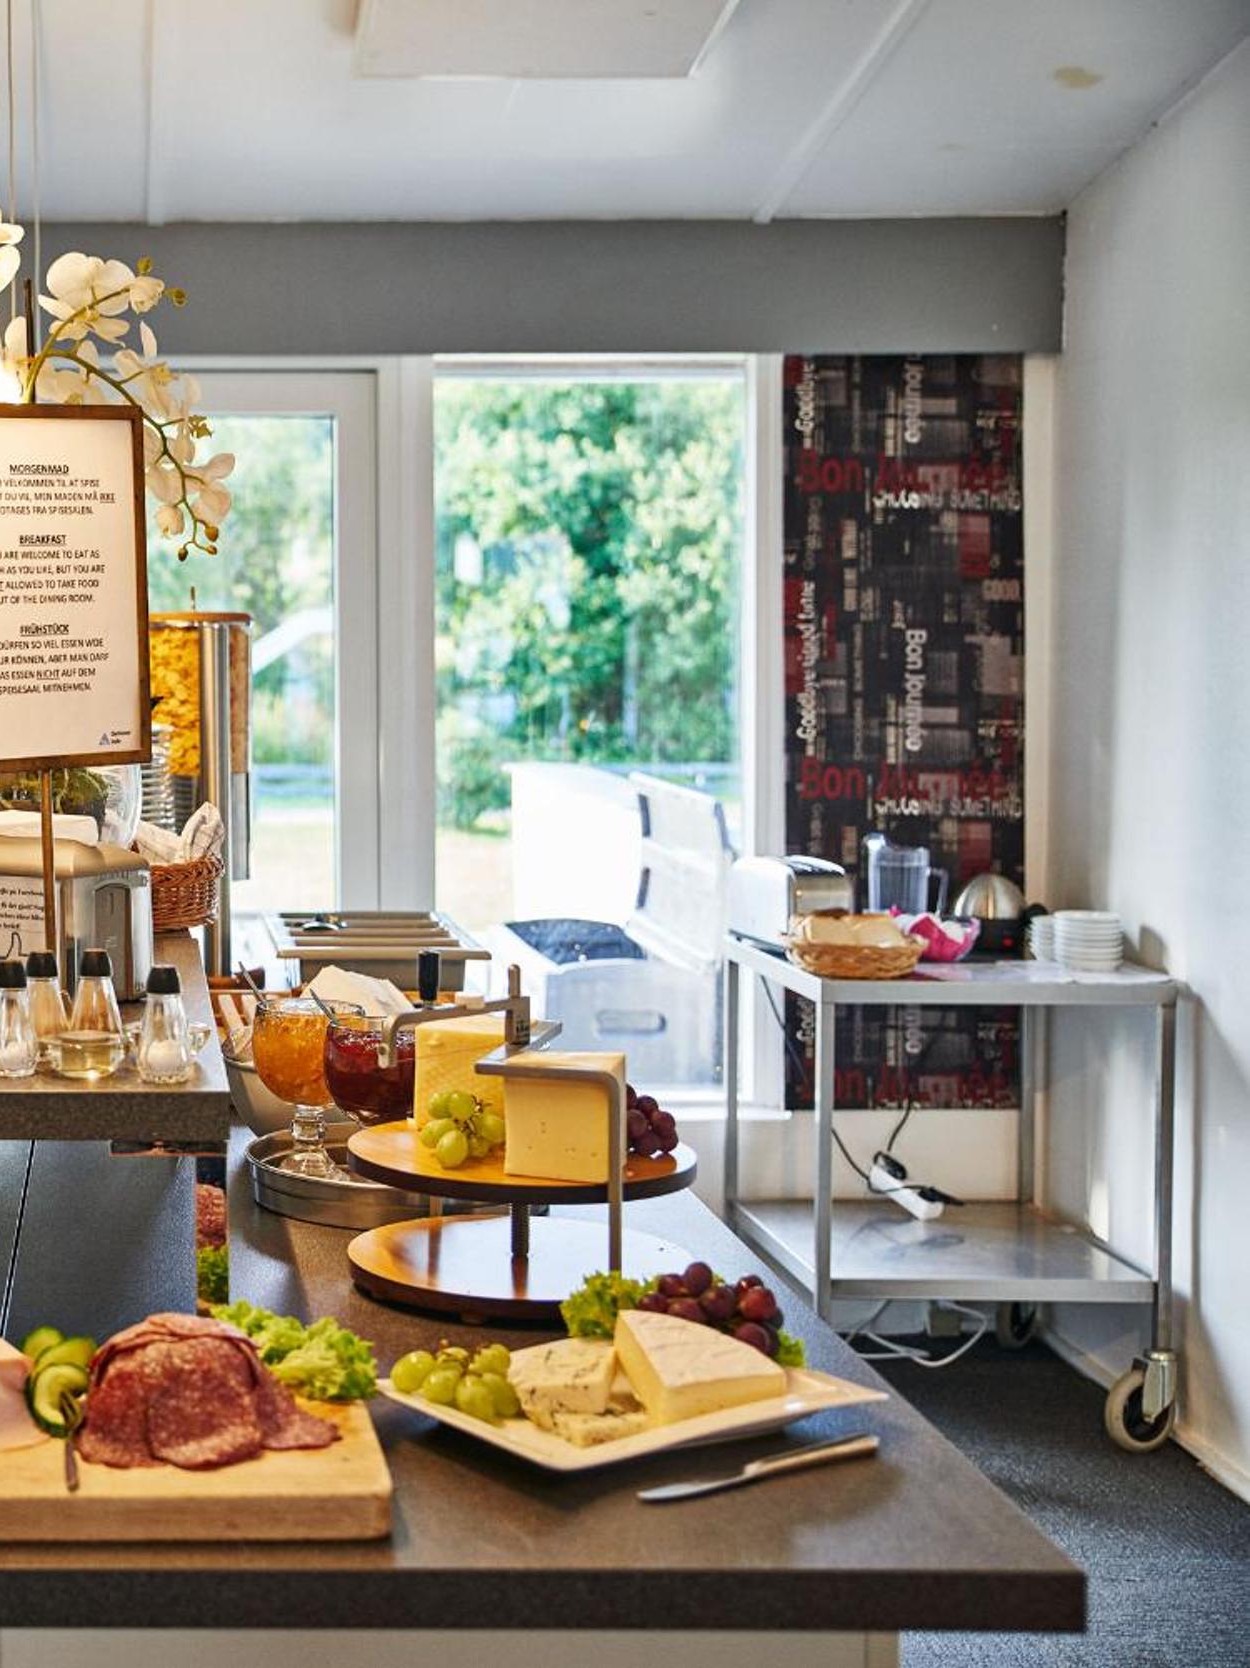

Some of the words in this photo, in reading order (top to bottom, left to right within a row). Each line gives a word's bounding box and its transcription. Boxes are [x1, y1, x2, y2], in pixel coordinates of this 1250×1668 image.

[10, 465, 69, 474] MORGENMAD
[69, 479, 77, 487] AT
[5, 493, 16, 501] DU
[34, 493, 52, 501] MEN
[19, 535, 66, 546] BREAKFAST
[4, 551, 18, 559] ARE
[21, 550, 60, 559] WELCOME
[62, 550, 72, 558] TO
[75, 550, 88, 558] EAT
[90, 550, 100, 558] AS
[6, 566, 16, 574] AS
[18, 566, 34, 574] YOU
[56, 565, 71, 573] BUT
[73, 565, 89, 573] YOU
[91, 565, 105, 573] ARE
[6, 580, 43, 589] ALLOWED
[46, 580, 55, 588] TO
[58, 580, 76, 588] TAKE
[78, 579, 99, 588] FOOD
[20, 623, 69, 636] FRÜHSTÜCK
[31, 640, 41, 649] SO
[61, 639, 83, 648] ESSEN
[905, 629, 927, 669] Bon
[48, 654, 67, 662] ABER
[70, 654, 88, 662] MAN
[12, 670, 34, 679] ESSEN
[78, 668, 95, 676] DEM
[801, 755, 864, 800] Bon
